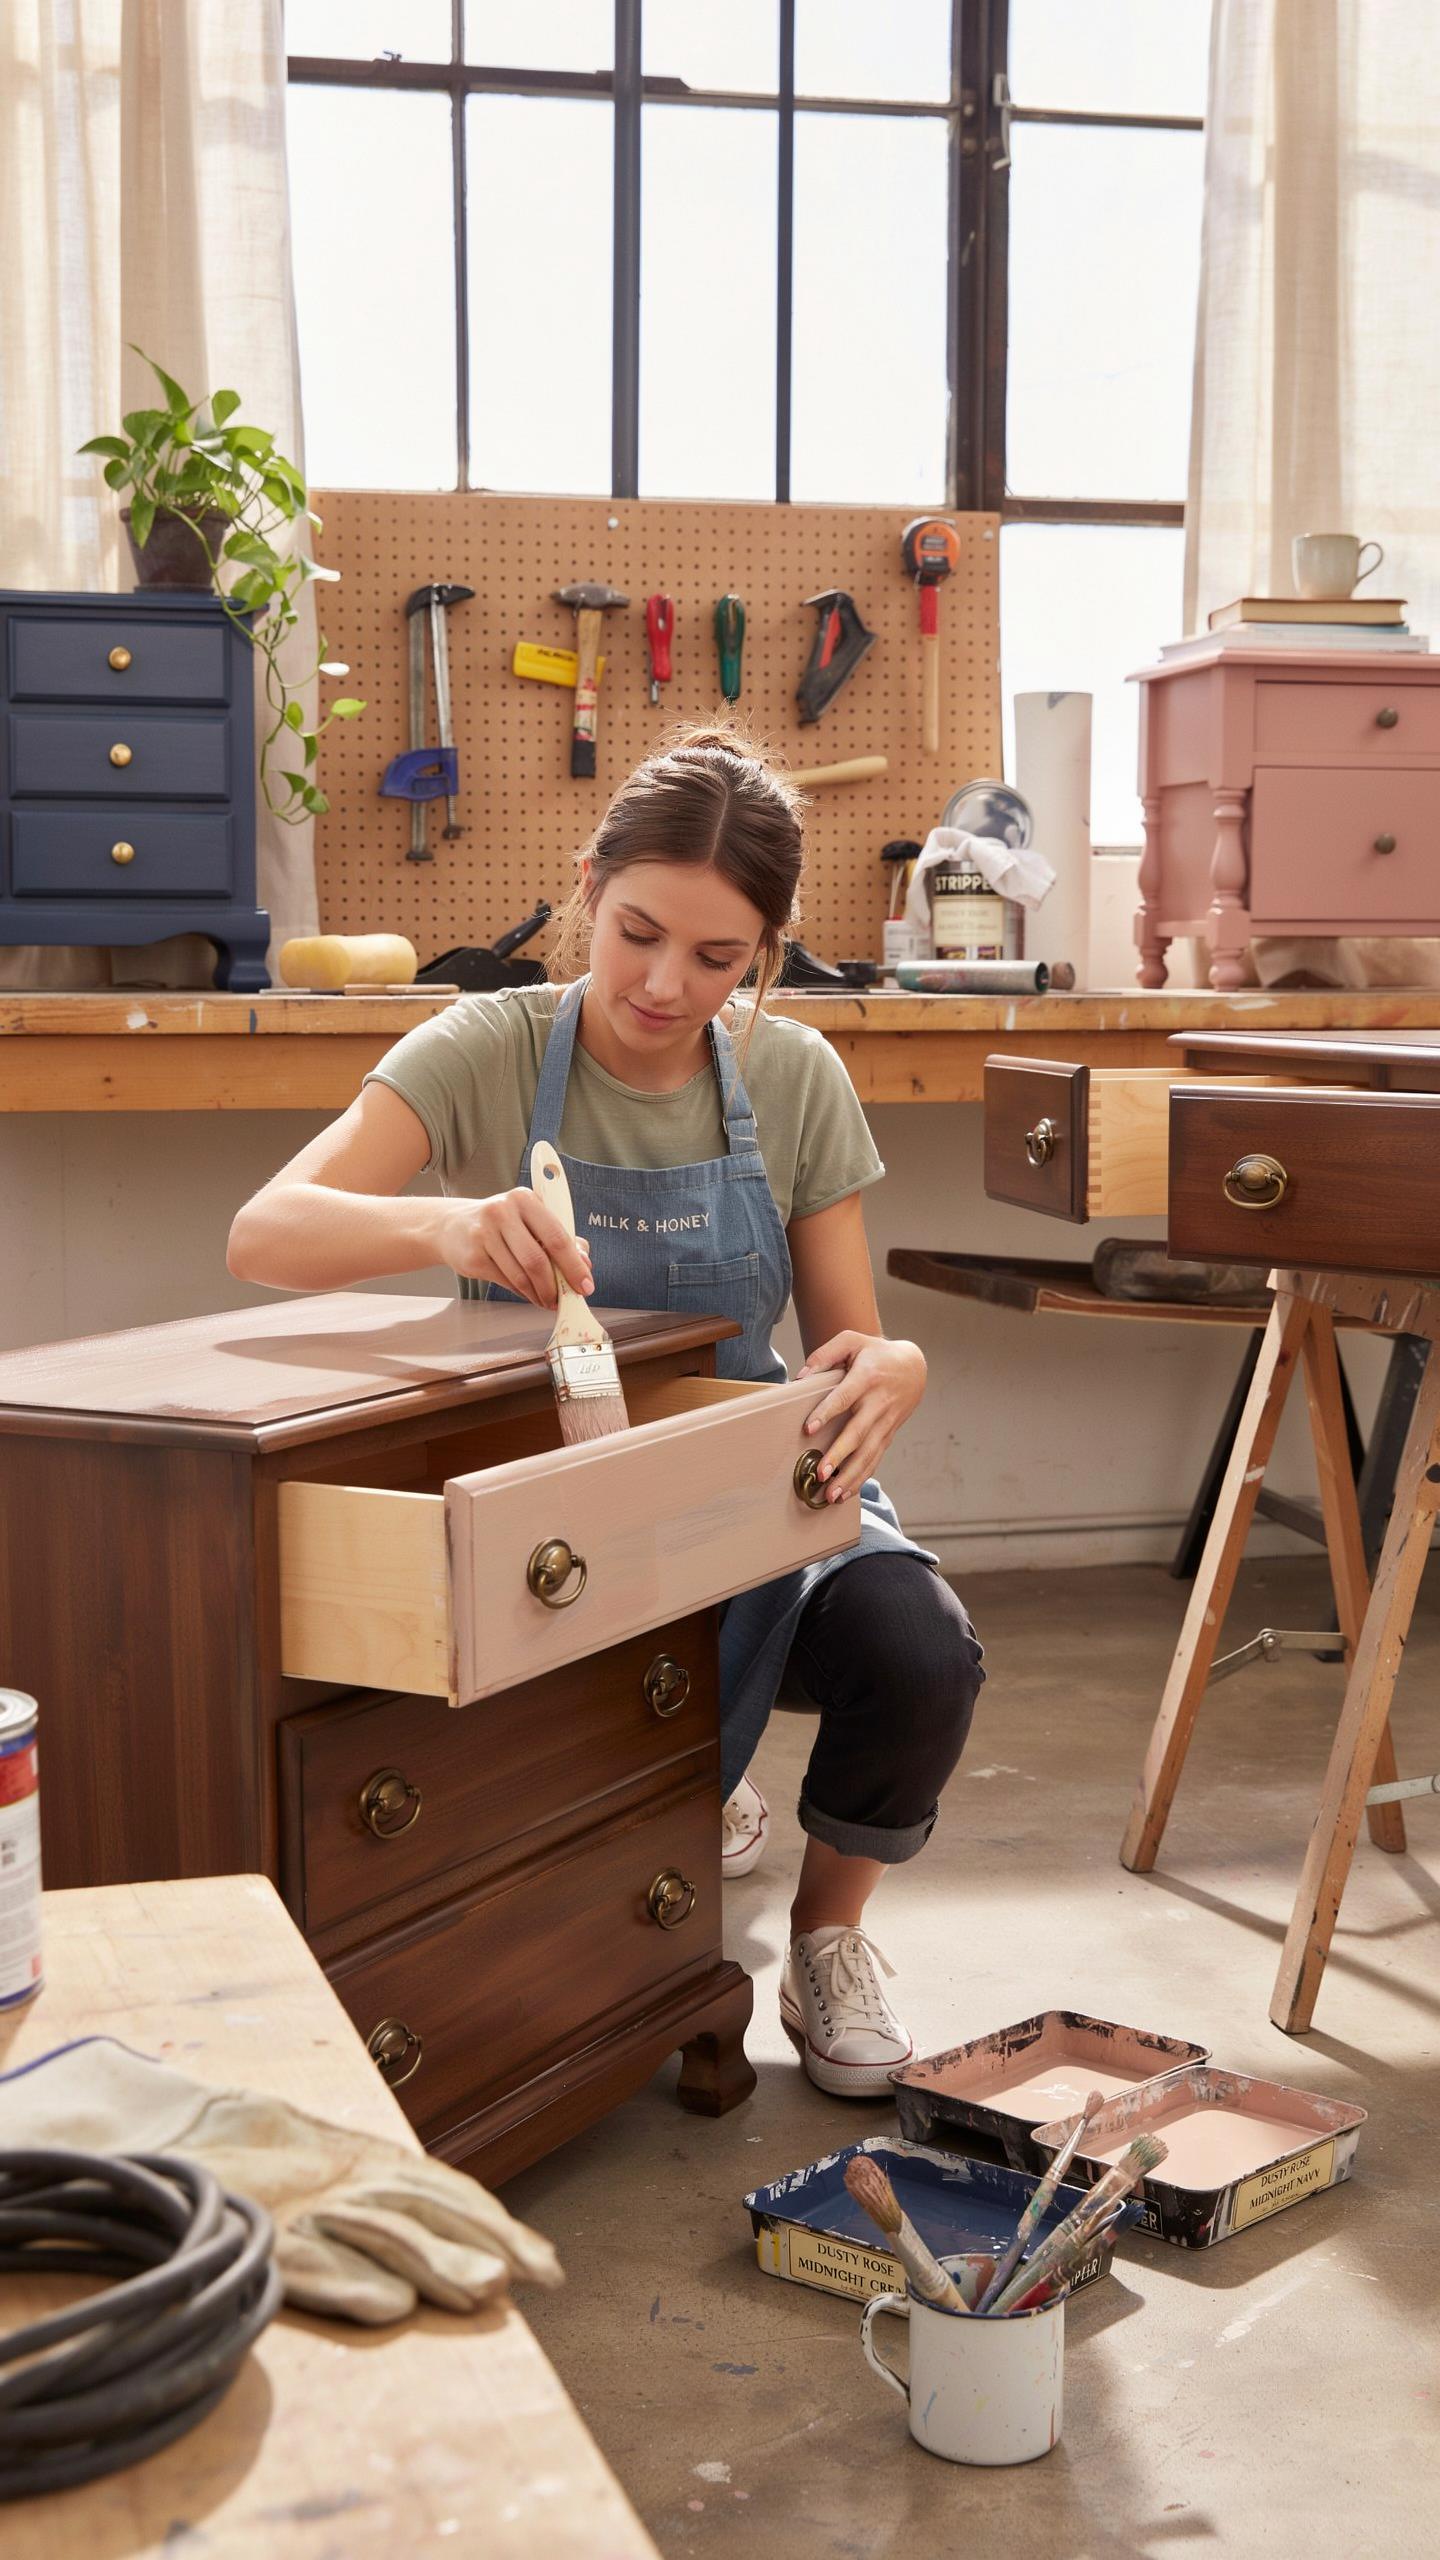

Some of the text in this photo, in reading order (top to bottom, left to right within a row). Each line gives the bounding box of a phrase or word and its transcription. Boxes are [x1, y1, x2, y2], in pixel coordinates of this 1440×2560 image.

[935, 875, 992, 891] STRIPPE
[588, 1212, 710, 1233] MILK & HONEY
[1261, 2155, 1311, 2187] DUSTY ROSE
[1249, 2179, 1295, 2209] MIDNIGHT
[1296, 2168, 1320, 2187] NAVY
[798, 2257, 865, 2288] MIDNIGHT
[817, 2243, 895, 2277] DUSTY ROSE
